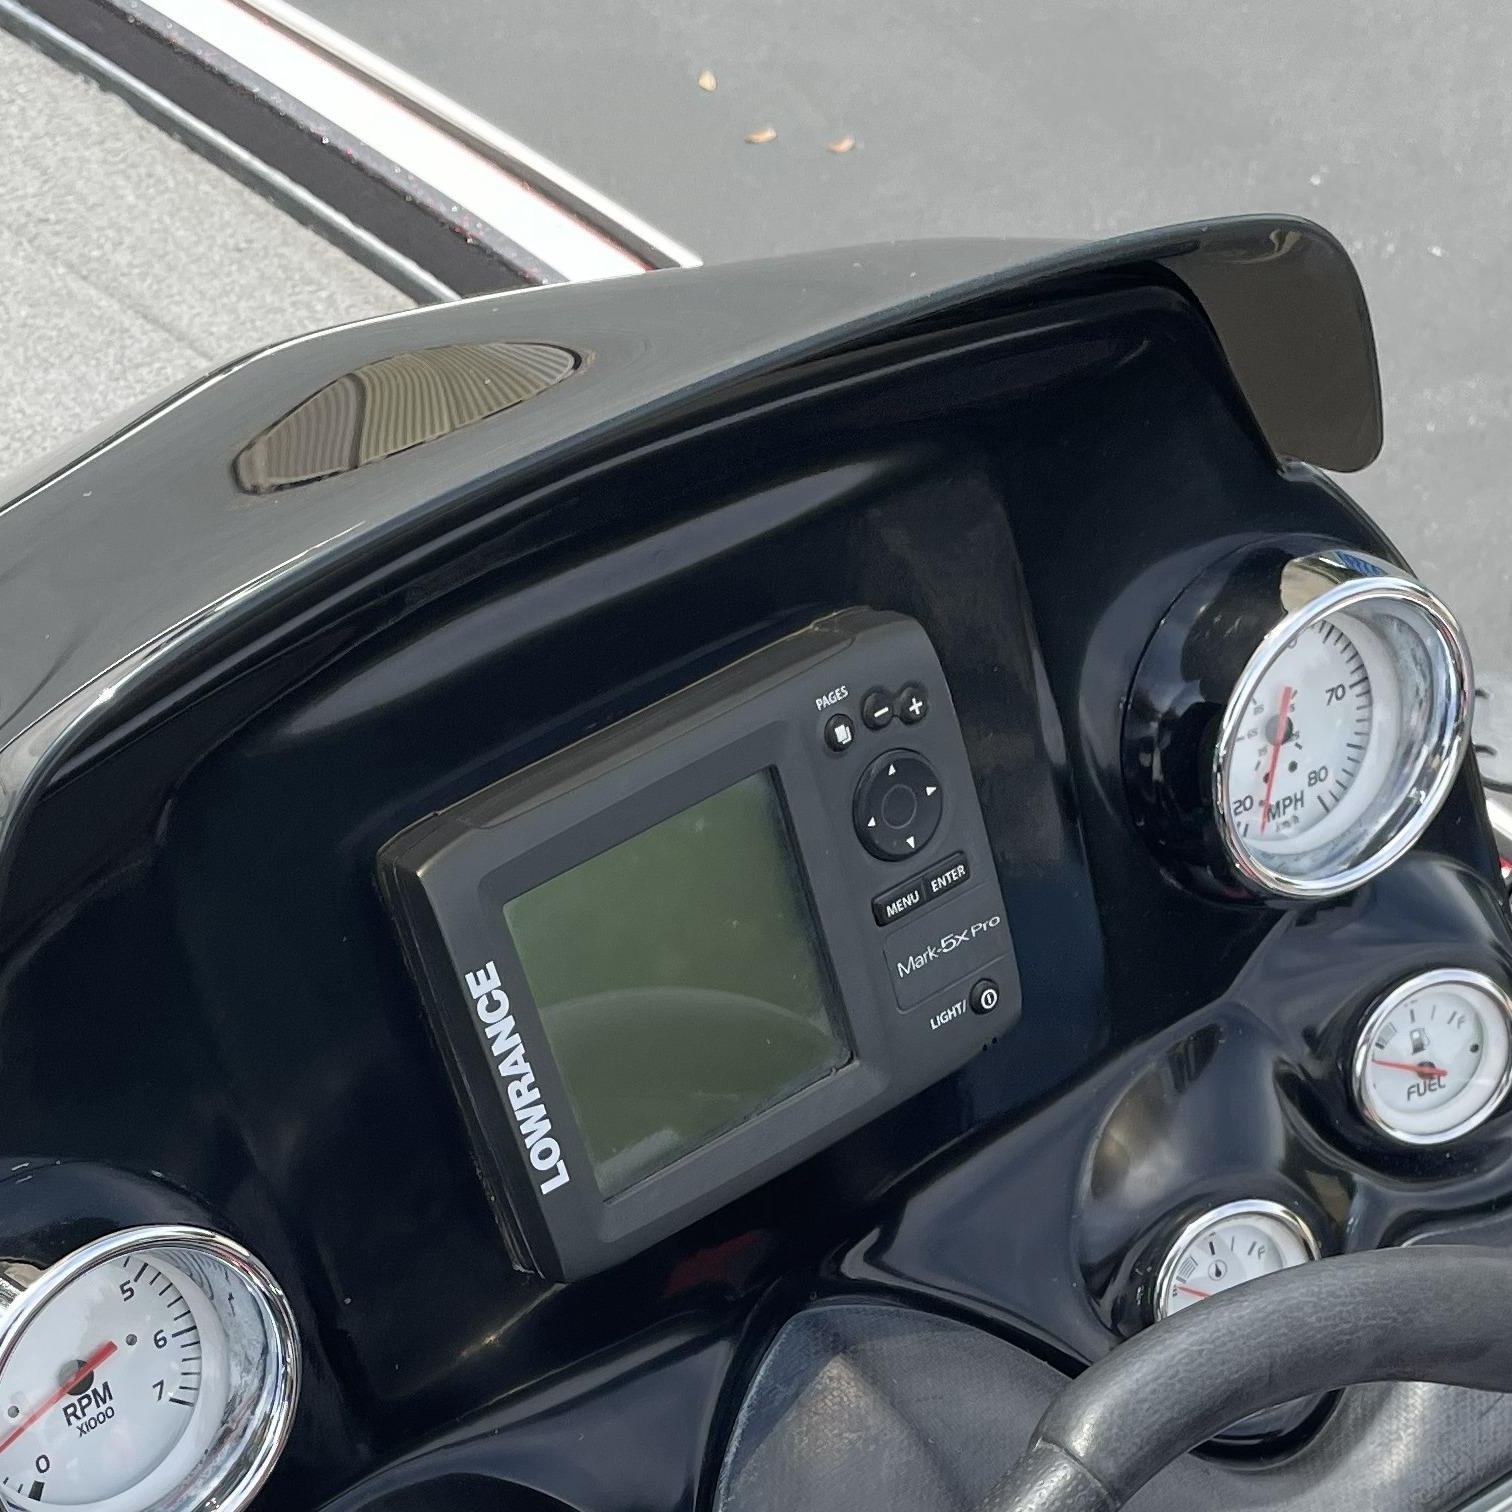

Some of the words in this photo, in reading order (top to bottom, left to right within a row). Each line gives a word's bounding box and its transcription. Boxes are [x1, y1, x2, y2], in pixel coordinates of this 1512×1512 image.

[815, 685, 849, 711] PAGES
[1325, 683, 1346, 706] 70
[1307, 766, 1328, 788] 80
[1232, 795, 1254, 816] 20
[1267, 790, 1305, 822] MPH
[886, 890, 920, 918] MENU
[931, 863, 966, 893] ENTER
[971, 914, 1001, 938] Pro
[464, 960, 572, 1195] LOWRANCE
[1407, 1074, 1446, 1102] FUEL
[119, 1280, 136, 1302] 5
[152, 1329, 168, 1350] 6
[152, 1379, 166, 1403] 7
[62, 1381, 114, 1427] RPM
[36, 1454, 51, 1475] 0
